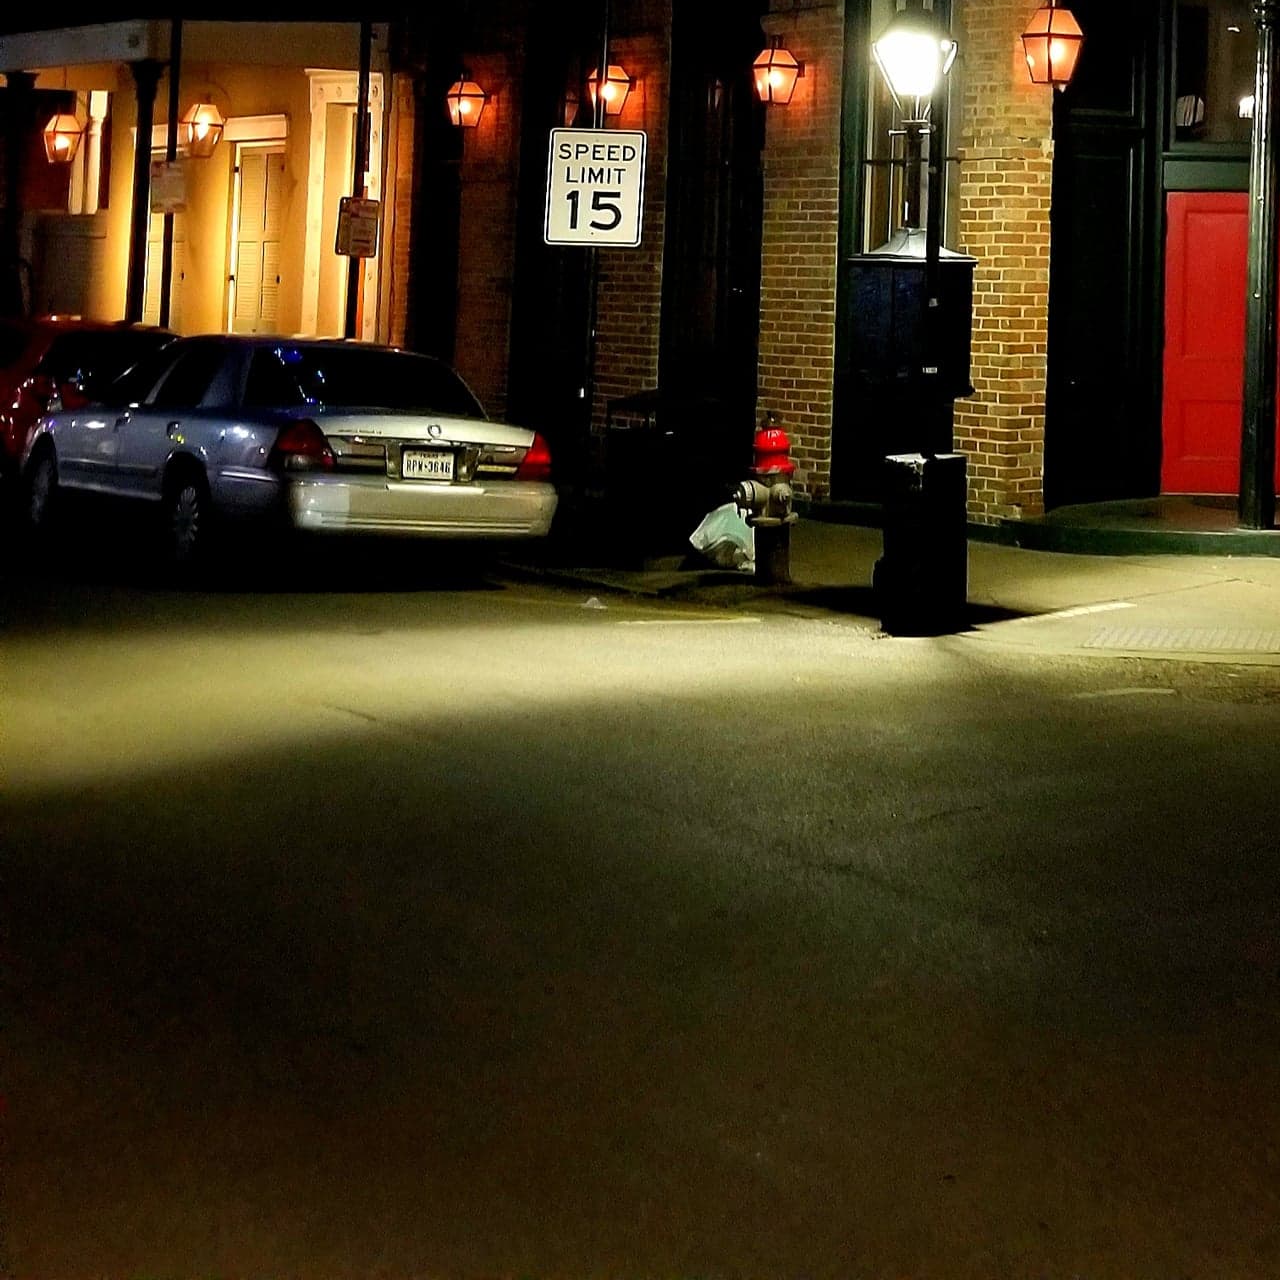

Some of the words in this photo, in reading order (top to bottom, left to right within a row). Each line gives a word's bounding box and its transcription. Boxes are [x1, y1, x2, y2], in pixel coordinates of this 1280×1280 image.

[559, 143, 636, 161] SPEED
[566, 166, 626, 184] LIMIT
[566, 190, 622, 230] 15
